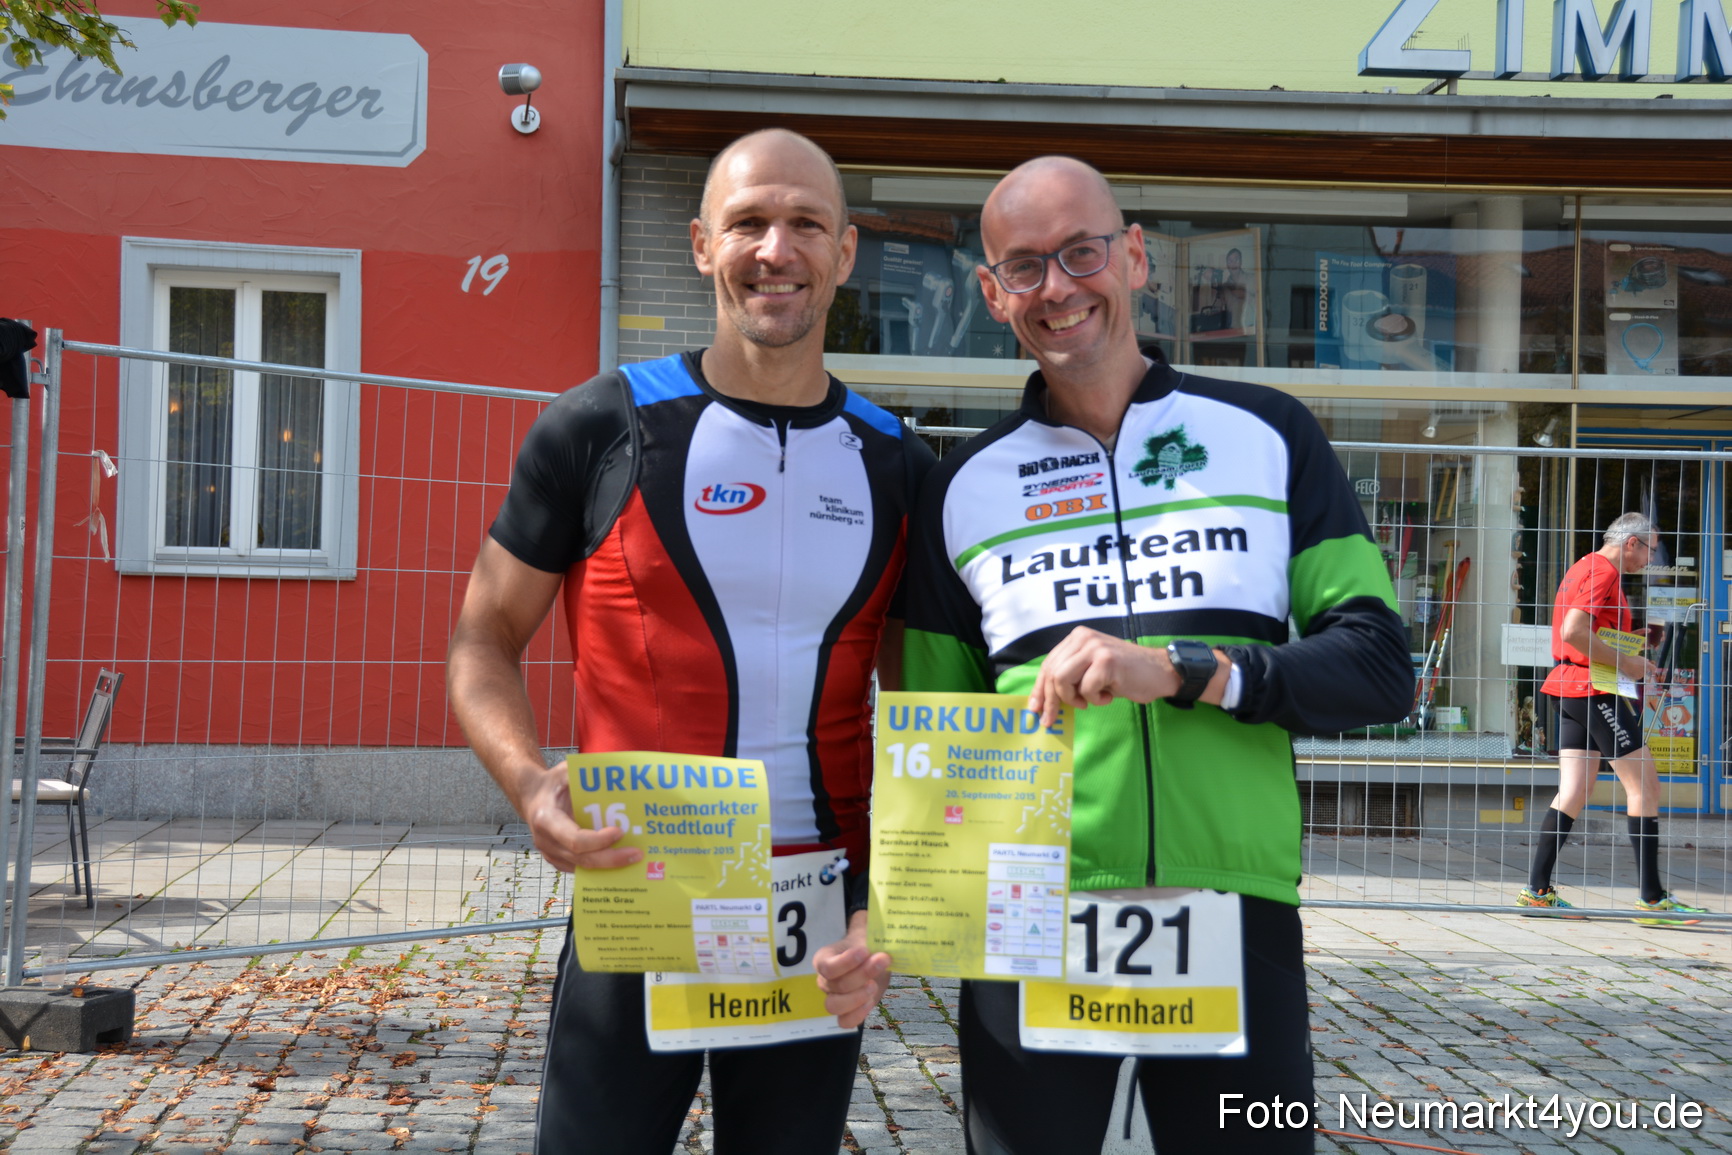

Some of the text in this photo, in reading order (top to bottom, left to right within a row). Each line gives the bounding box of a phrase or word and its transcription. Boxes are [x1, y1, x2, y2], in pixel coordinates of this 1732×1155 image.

[0, 39, 385, 136] Ehrnsberger
[460, 253, 510, 296] 19
[1319, 259, 1329, 331] PROXXON
[1060, 452, 1100, 469] RACER
[1023, 474, 1087, 491] SYNERGY
[1040, 480, 1095, 496] SPORTS
[1355, 481, 1380, 495] FELCO
[702, 484, 746, 504] tkn
[819, 494, 843, 505] team
[825, 504, 864, 517] klinikum
[1025, 493, 1107, 521] OBI
[810, 511, 853, 525] nürnberg
[1002, 526, 1248, 586] Laufteam
[1053, 565, 1204, 612] Fürth
[1599, 630, 1642, 644] URKUNDE
[888, 705, 1064, 735] URKUNDE
[1597, 702, 1631, 748] skinfit
[886, 742, 942, 779] 16.
[947, 745, 1063, 763] Neumarkter
[579, 764, 758, 792] URKUNDE
[946, 764, 1039, 784] Stadtlauf
[962, 790, 1012, 800] September
[1014, 792, 1036, 800] 2015
[644, 800, 759, 817] Neumarkter
[583, 802, 642, 836] 16.
[646, 818, 736, 838] Stadtlauf
[648, 846, 735, 856] 20. September 2015
[613, 896, 634, 904] Grau
[776, 900, 807, 967] 3
[1070, 903, 1190, 976] 121
[709, 988, 792, 1019] Henrik
[1069, 994, 1194, 1025] Bernhard
